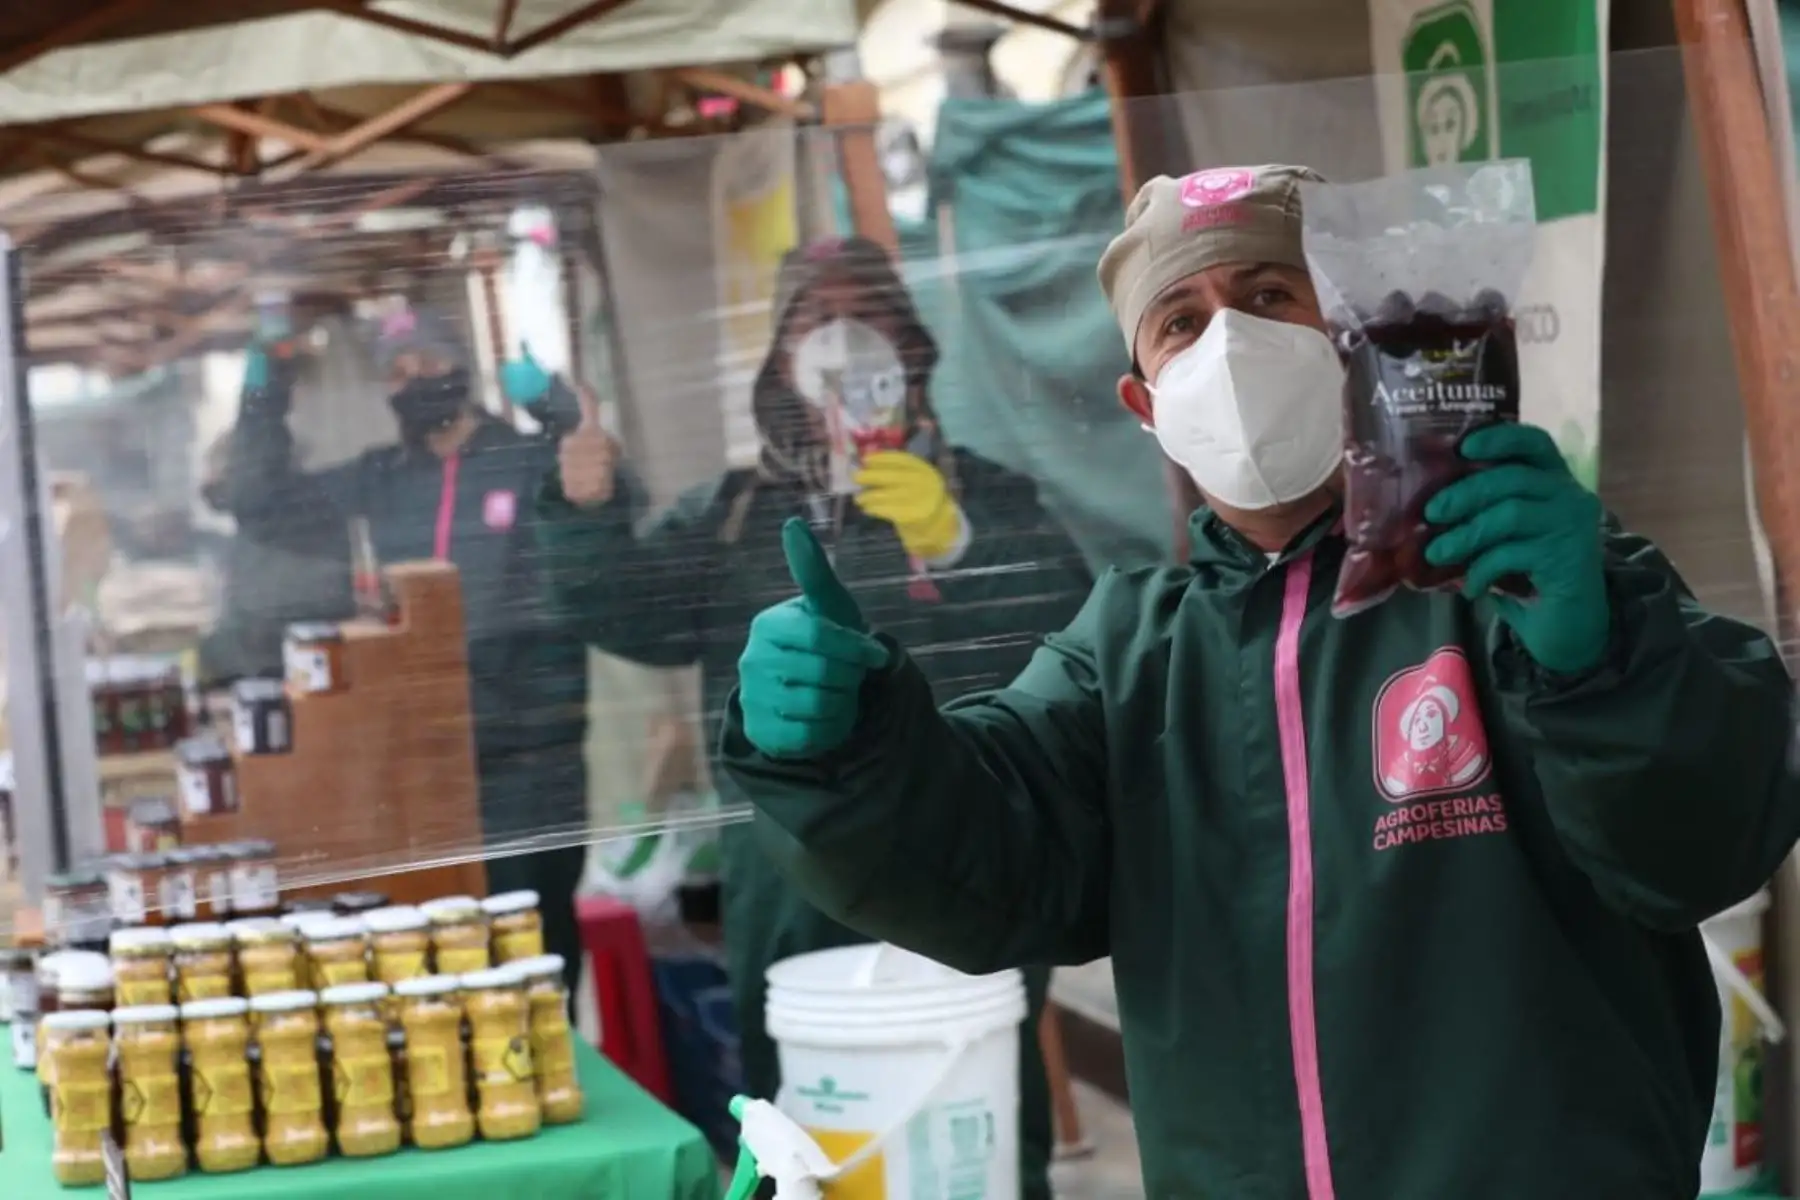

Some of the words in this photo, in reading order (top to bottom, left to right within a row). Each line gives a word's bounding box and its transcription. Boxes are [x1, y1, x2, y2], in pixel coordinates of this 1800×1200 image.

[1369, 377, 1507, 406] Aceitunas
[1375, 794, 1503, 833] AGROFERIAS
[1373, 814, 1508, 850] CAMPESINAS
